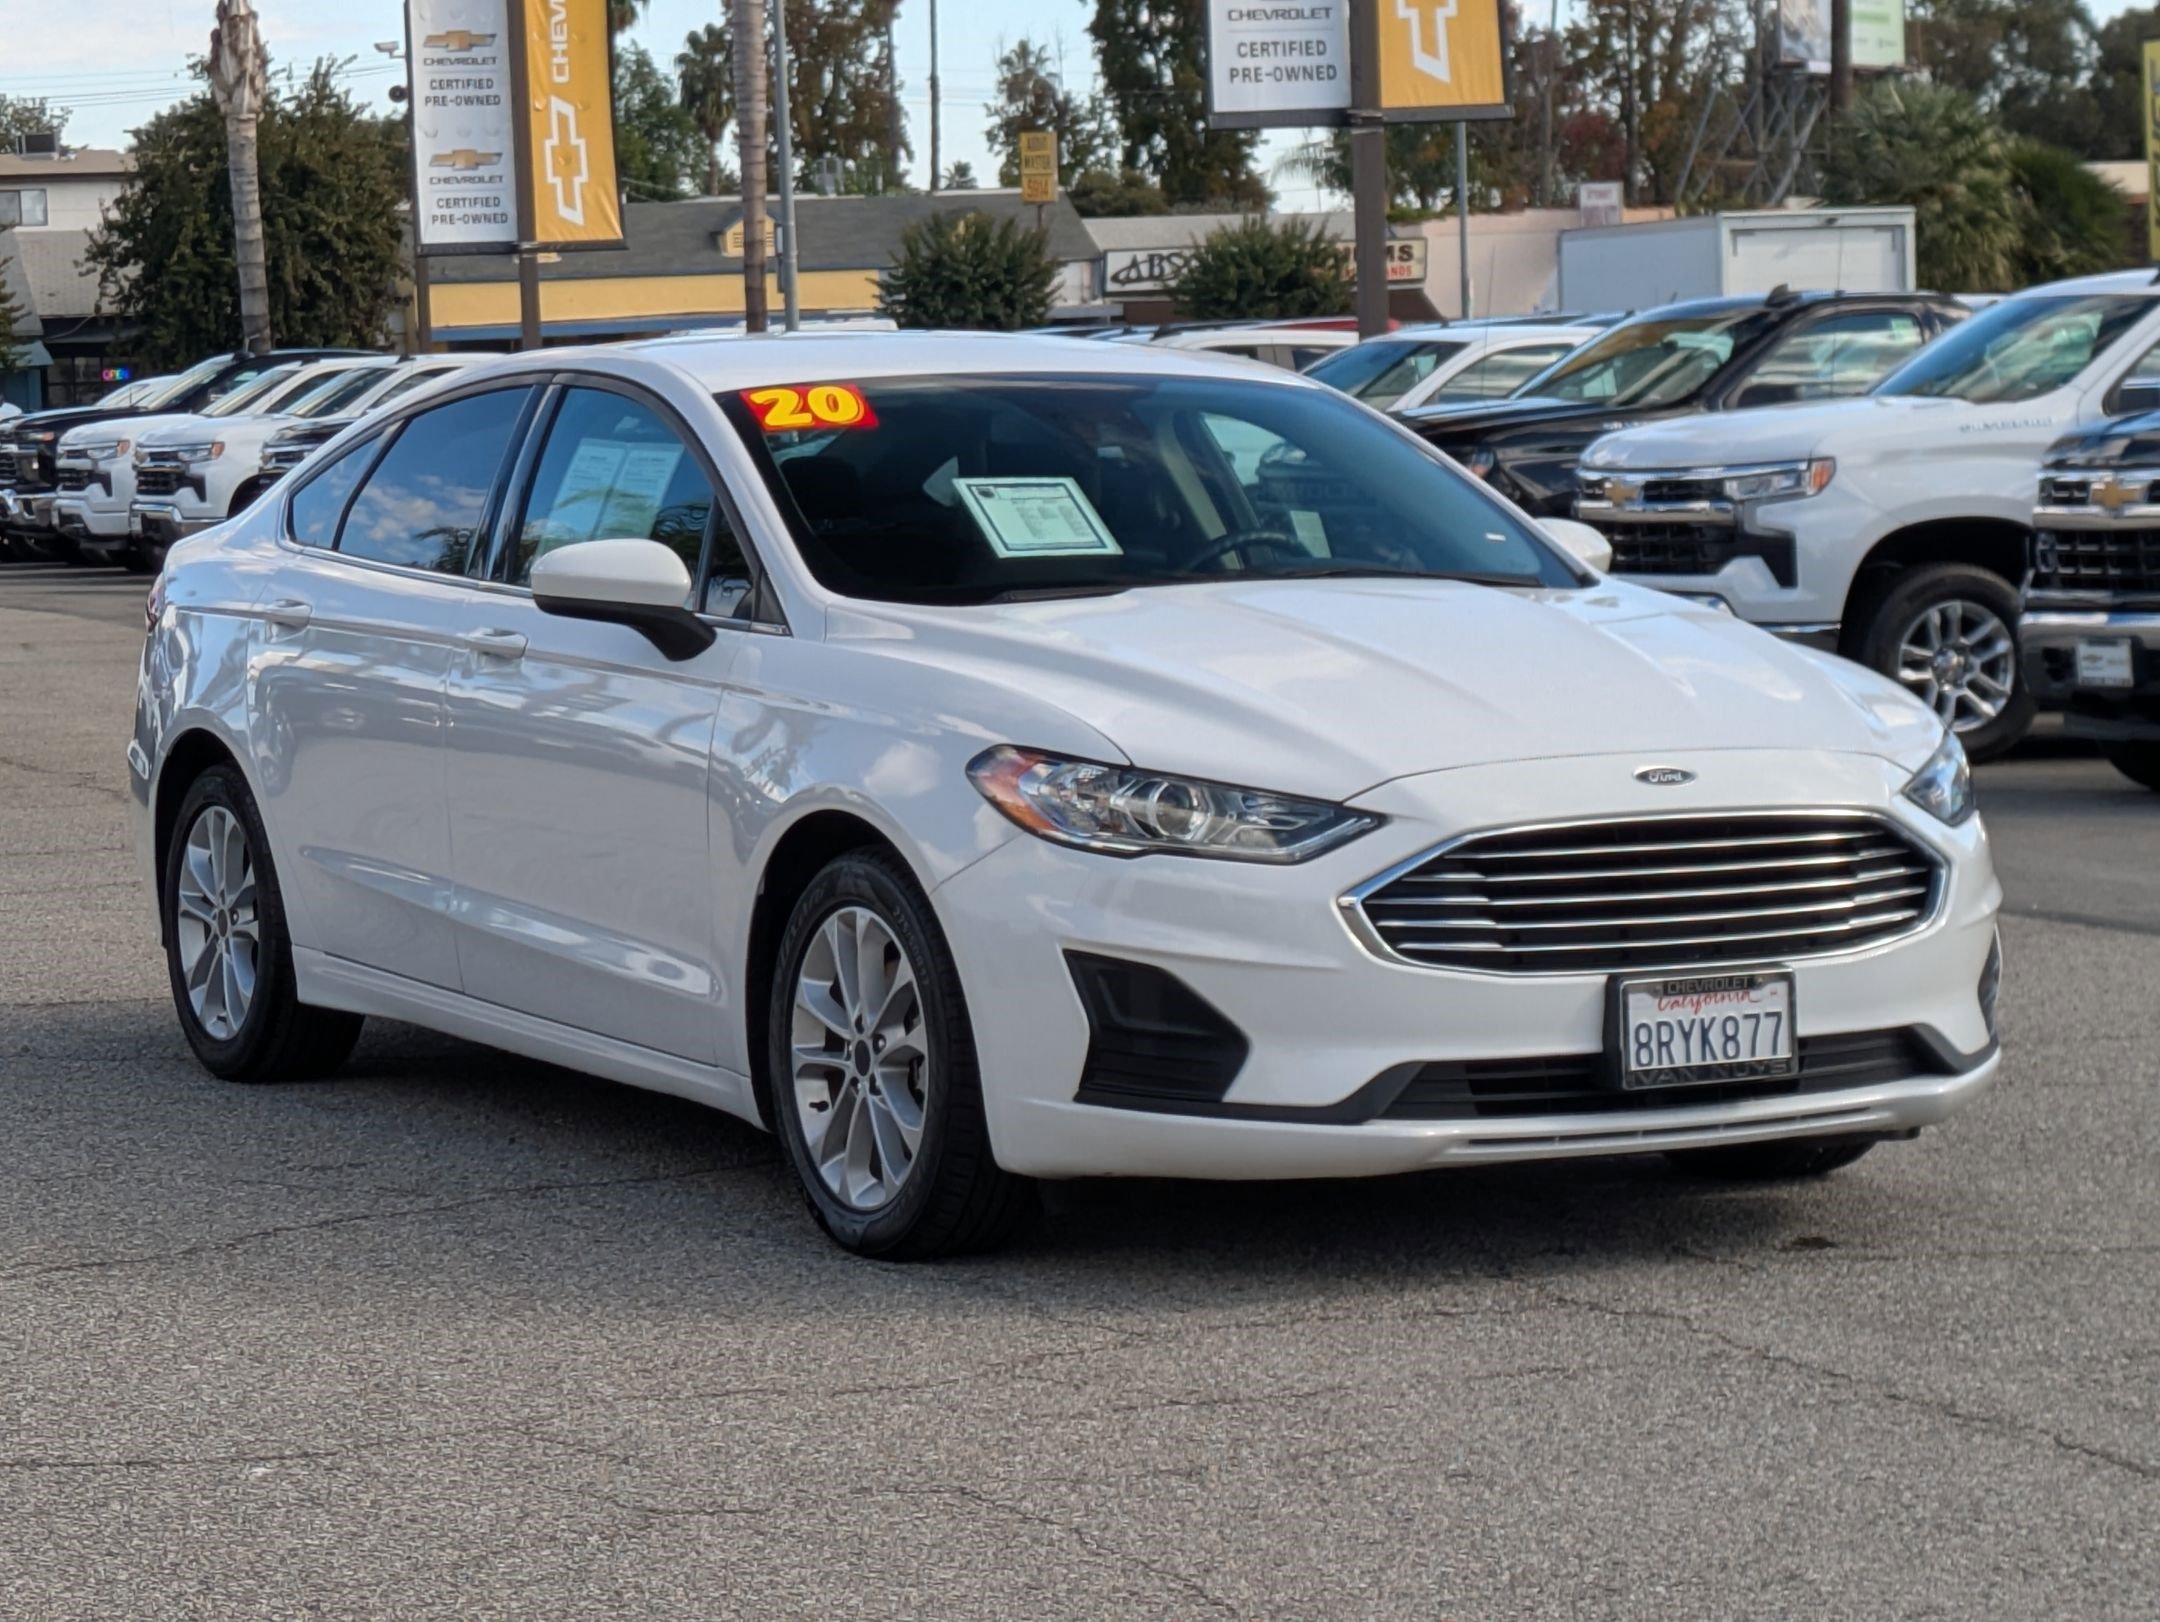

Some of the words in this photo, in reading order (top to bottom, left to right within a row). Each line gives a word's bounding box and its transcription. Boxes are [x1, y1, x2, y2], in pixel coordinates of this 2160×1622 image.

[1228, 7, 1333, 21] CHEVROLET
[1237, 40, 1328, 59] CERTIFIED
[423, 56, 498, 66] CHEVROLET
[1229, 64, 1338, 84] PRE-OWNED
[430, 78, 494, 91] CERTIFIED
[424, 94, 501, 107] PRE-OWNED
[429, 174, 504, 185] CHEVROLET
[436, 197, 501, 209] CERTIFIED
[431, 212, 508, 225] PRE-OWNED
[749, 386, 865, 427] 20
[1649, 770, 1683, 783] Ford
[1667, 976, 1750, 996] CHEVROLET
[1657, 989, 1761, 1015] California
[1634, 1011, 1783, 1068] 8RYK877
